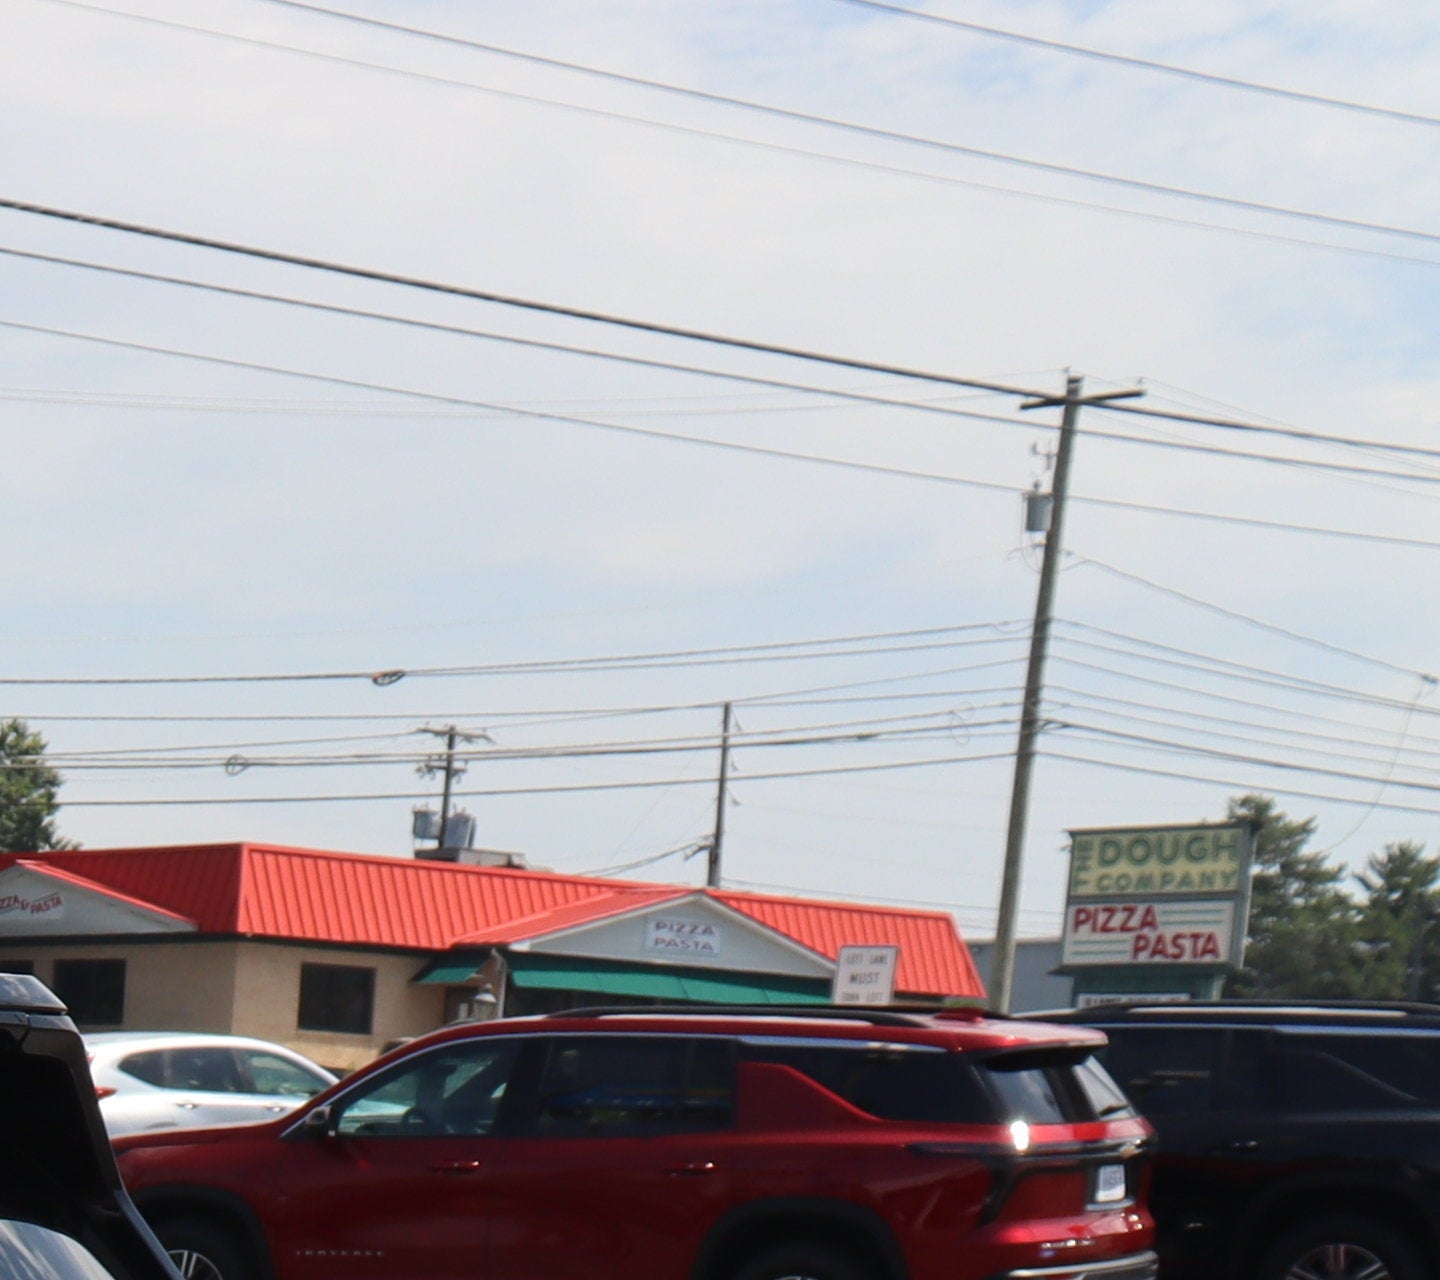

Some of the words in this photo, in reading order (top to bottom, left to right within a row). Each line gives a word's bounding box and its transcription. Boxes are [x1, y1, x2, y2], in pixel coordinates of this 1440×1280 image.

[1098, 832, 1237, 869] DOUGH
[1096, 870, 1237, 892] COMPANY
[30, 895, 63, 915] PASTA
[655, 920, 715, 937] PIZZA
[1072, 905, 1160, 934] PIZZA
[654, 936, 714, 951] PASTA
[1132, 931, 1221, 960] PASTA
[849, 971, 881, 986] MUST
